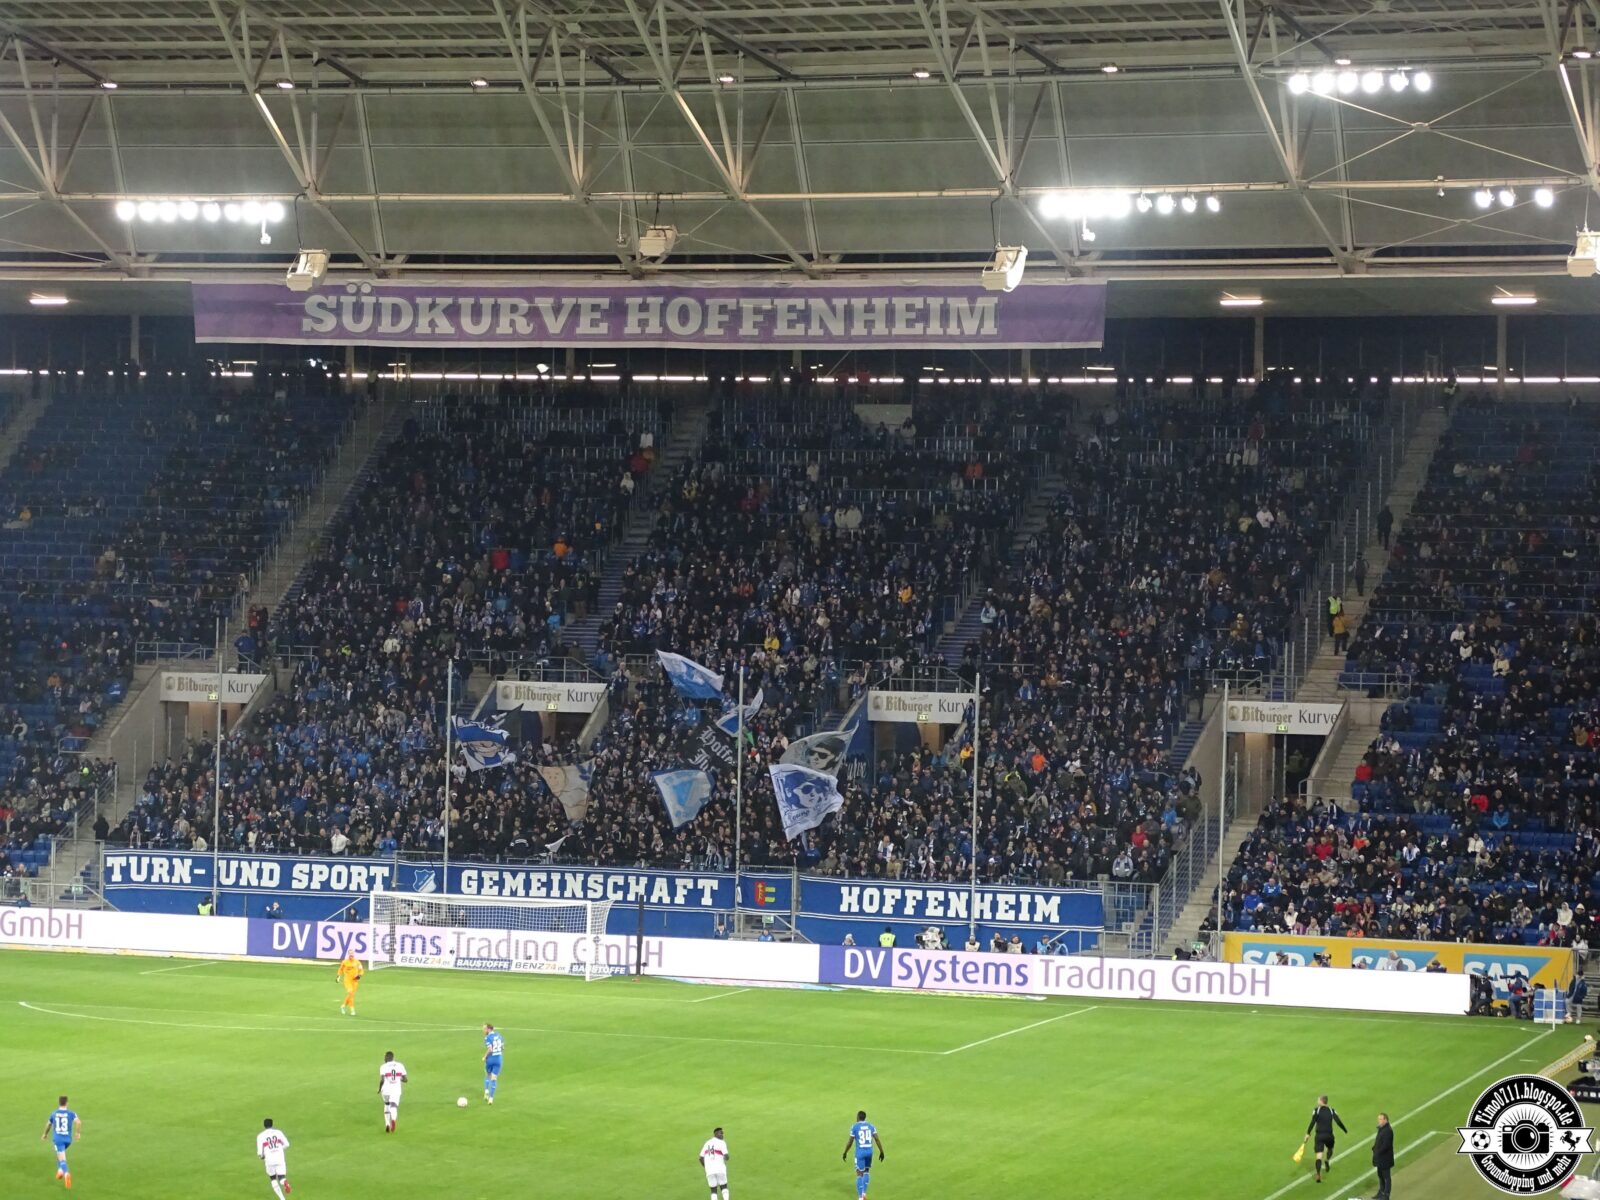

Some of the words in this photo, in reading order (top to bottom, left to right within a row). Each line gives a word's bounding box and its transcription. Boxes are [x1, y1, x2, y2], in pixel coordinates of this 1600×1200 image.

[302, 282, 609, 336] SÜDKURVE
[624, 296, 998, 337] HOFFENHEIM
[177, 677, 218, 693] Bitburge
[228, 680, 260, 693] Kurv
[514, 686, 561, 703] Bitburger
[885, 696, 933, 714] Bitburger
[1241, 706, 1292, 725] Bitburger
[1299, 709, 1338, 725] Kurve
[106, 856, 206, 883] TURN-
[218, 859, 281, 888] UND
[292, 863, 390, 892] SPORT
[460, 869, 719, 906] GEMEINSCHAFT
[840, 886, 1061, 923] HOFFENHEIM
[0, 907, 83, 940] GmbH
[272, 922, 312, 952] DV
[321, 924, 442, 959] Systems
[456, 959, 510, 970] BAUSTOFFE
[572, 965, 626, 975] BASTOFFE
[844, 948, 886, 980] DV
[897, 951, 1029, 988] Systems
[1039, 958, 1155, 999] Trading
[1171, 963, 1270, 997] GmbH
[55, 1117, 69, 1132] 13
